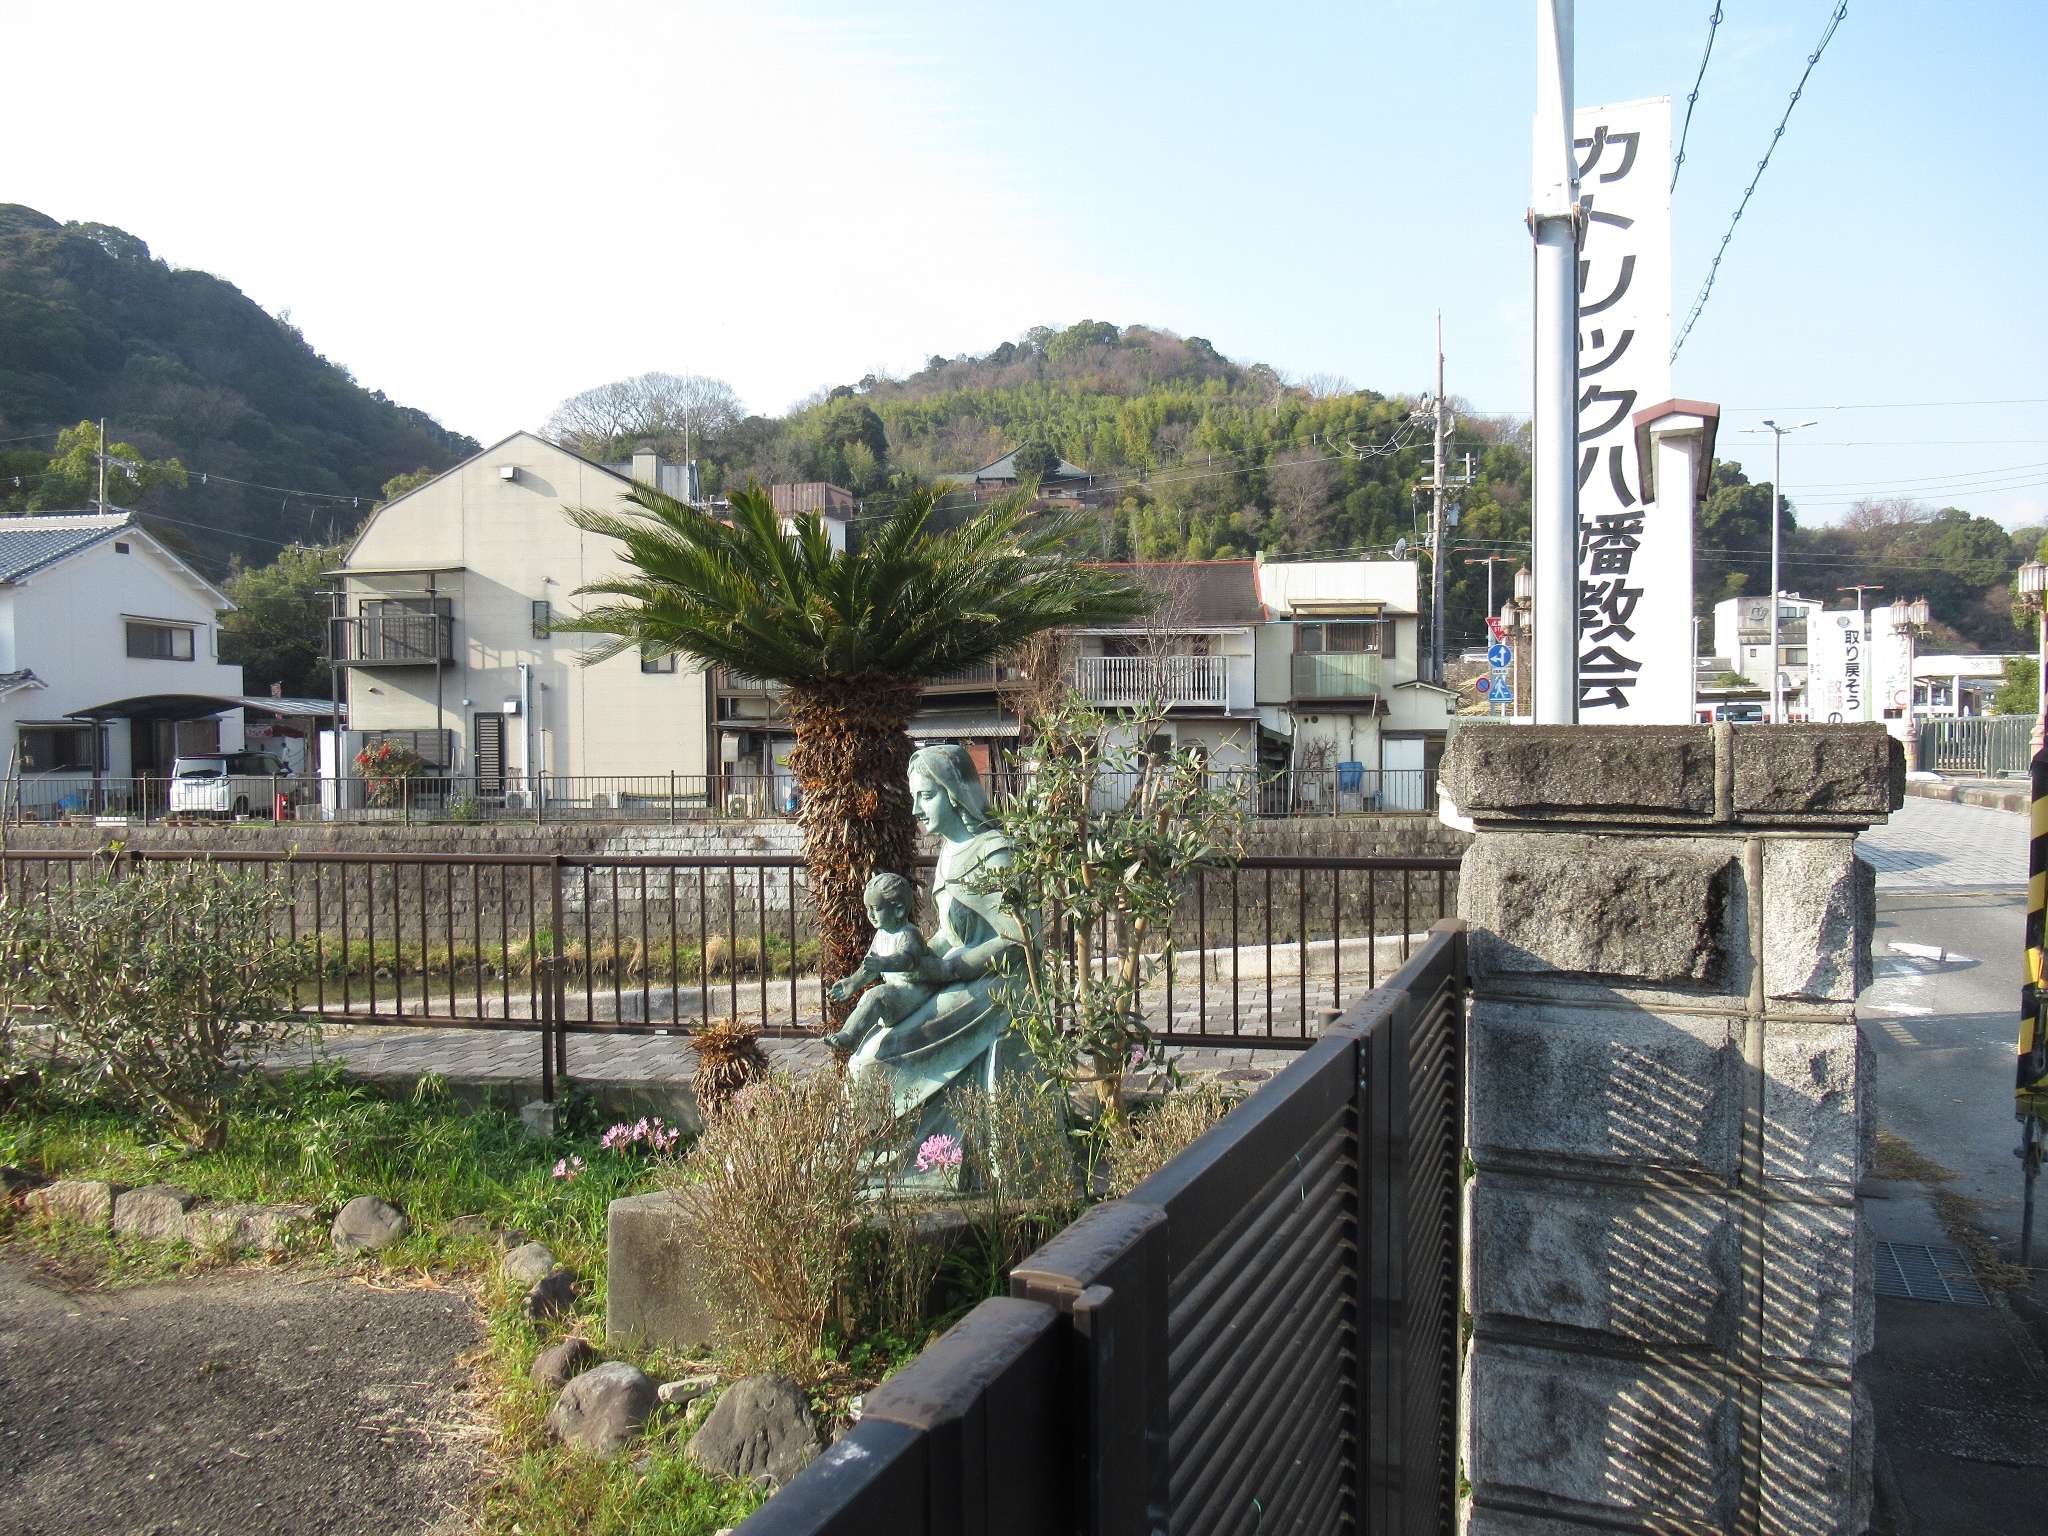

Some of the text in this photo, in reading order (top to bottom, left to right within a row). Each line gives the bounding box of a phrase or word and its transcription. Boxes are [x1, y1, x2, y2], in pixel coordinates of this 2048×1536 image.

[1845, 630, 1861, 711] 取り戻そう
